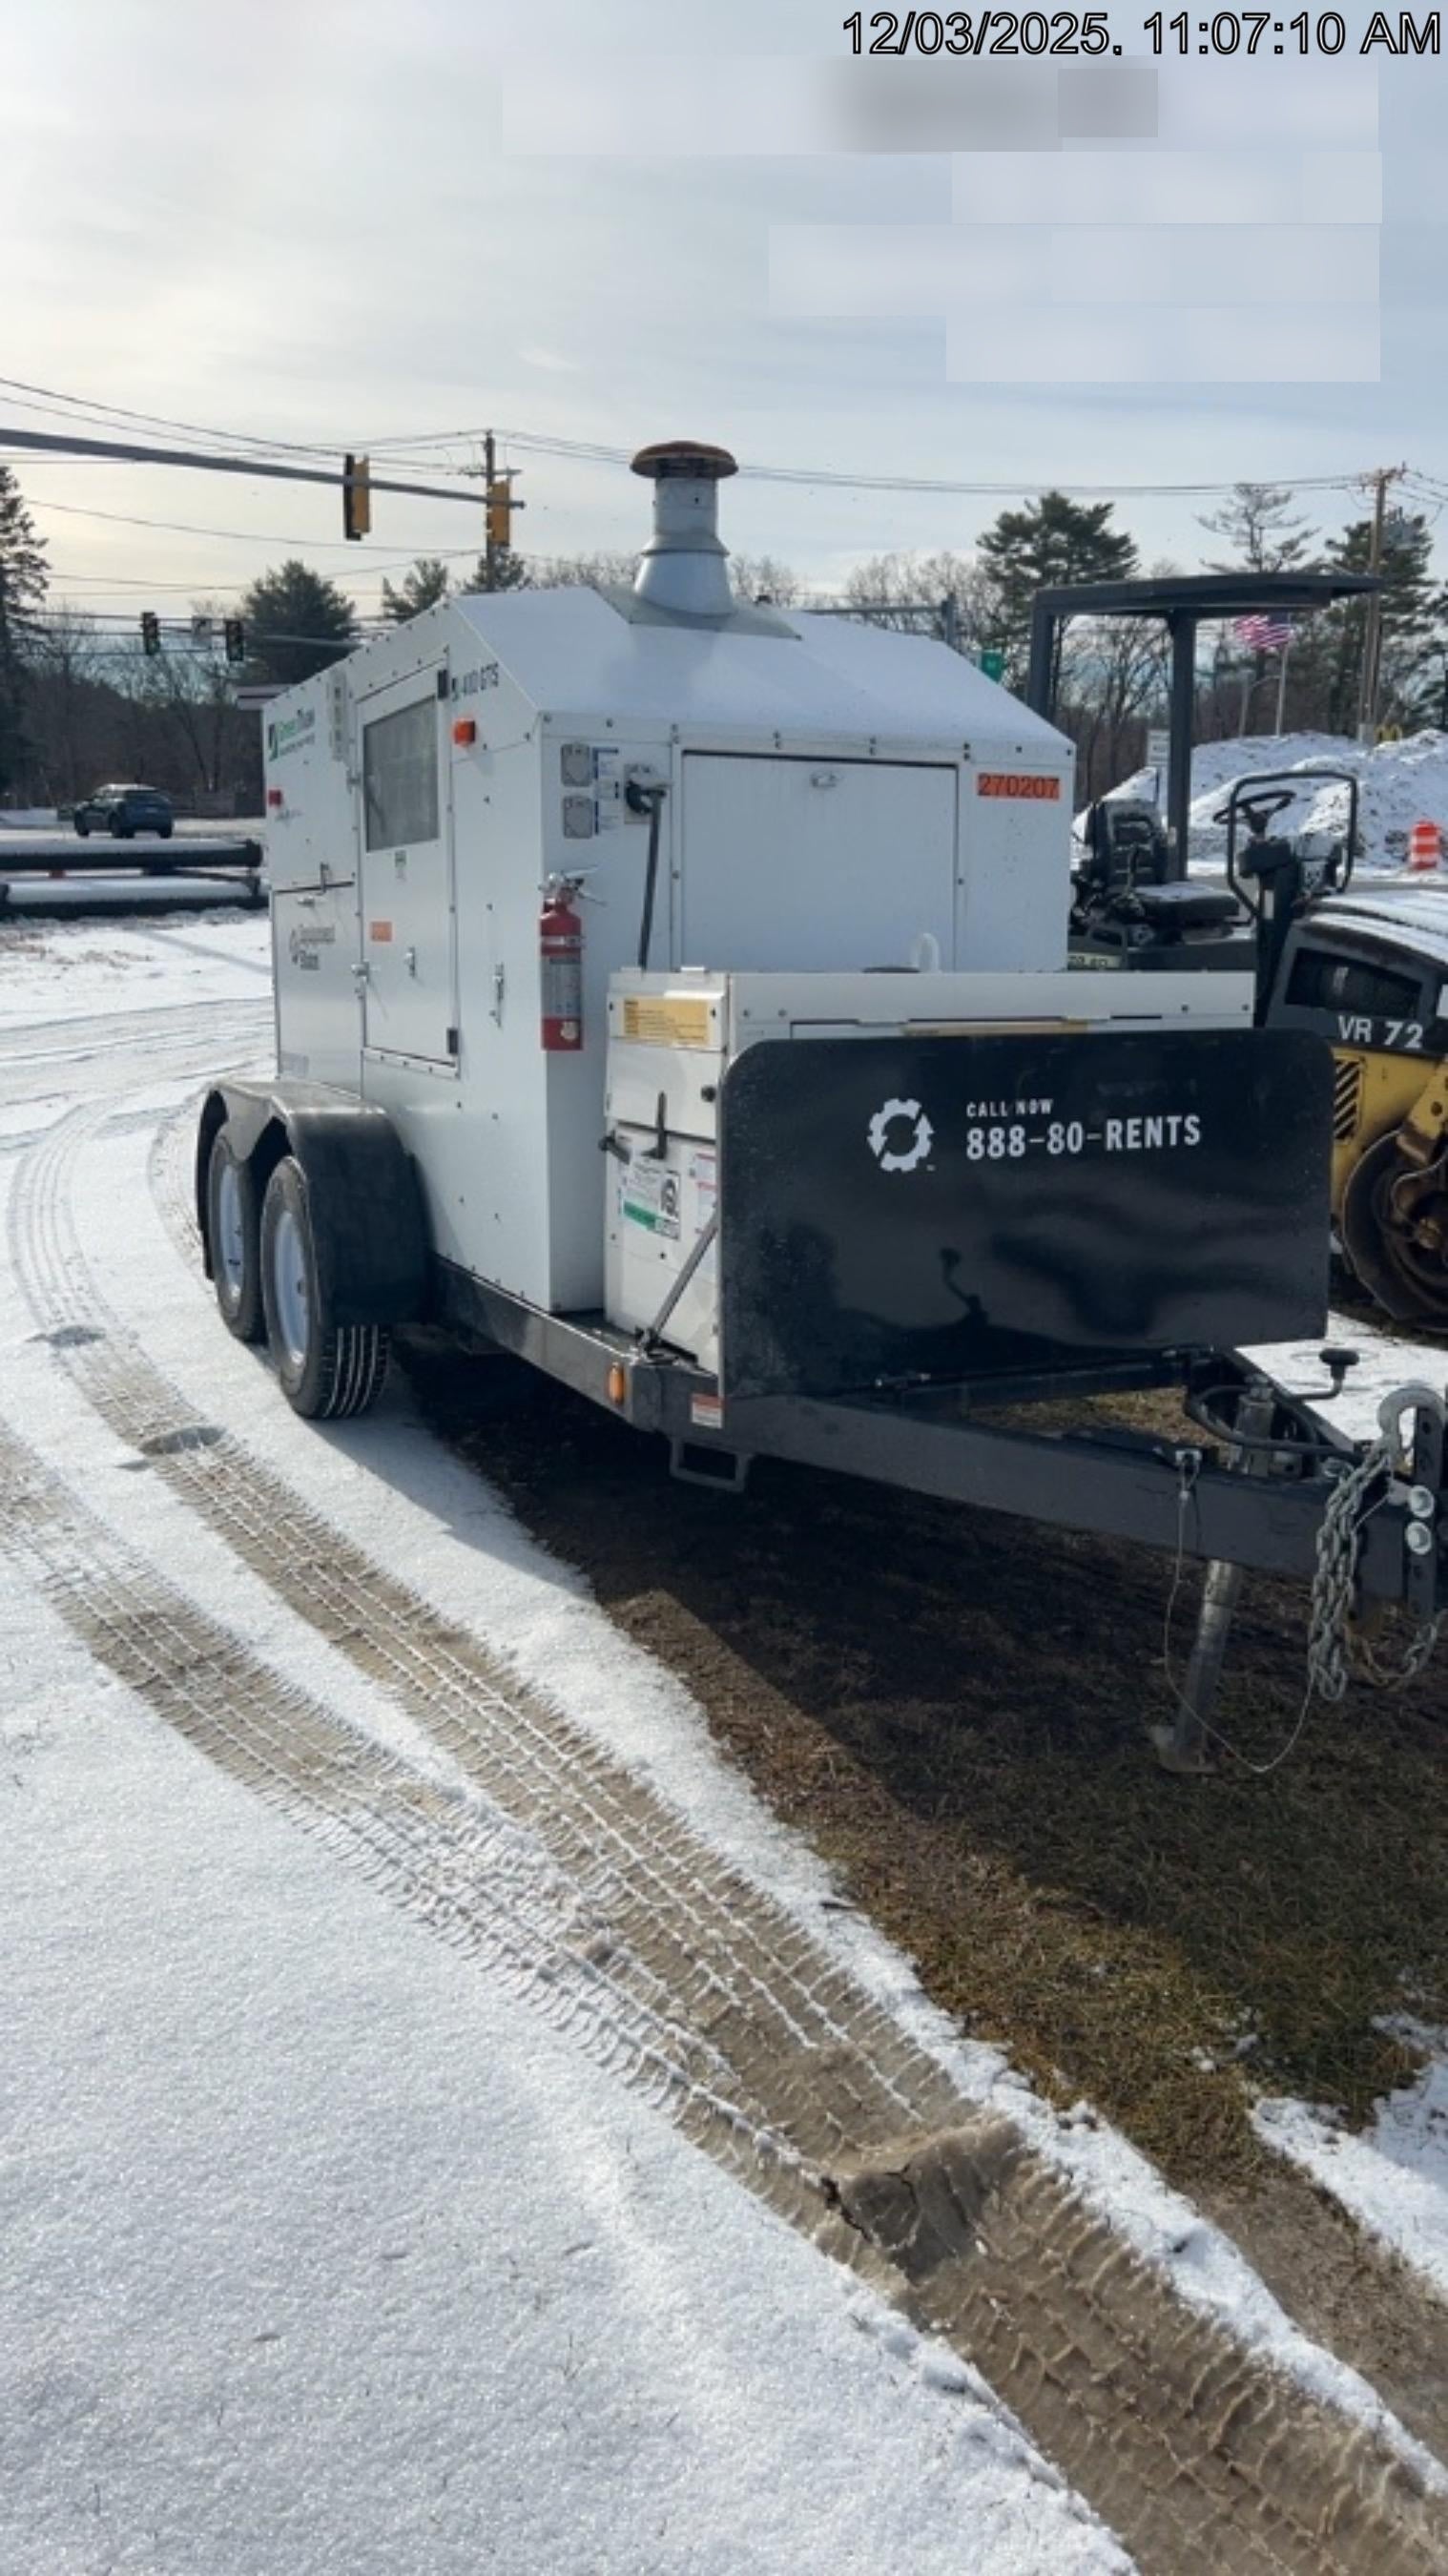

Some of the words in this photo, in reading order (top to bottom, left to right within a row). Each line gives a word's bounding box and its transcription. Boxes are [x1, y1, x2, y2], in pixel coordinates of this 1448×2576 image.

[977, 773, 1060, 800] 270207
[1337, 1014, 1372, 1043] VR
[1383, 1020, 1424, 1049] 72
[965, 1101, 1008, 1118] CALL
[1015, 1098, 1054, 1115] NOW
[965, 1113, 1201, 1160] 888-80-RENTS
